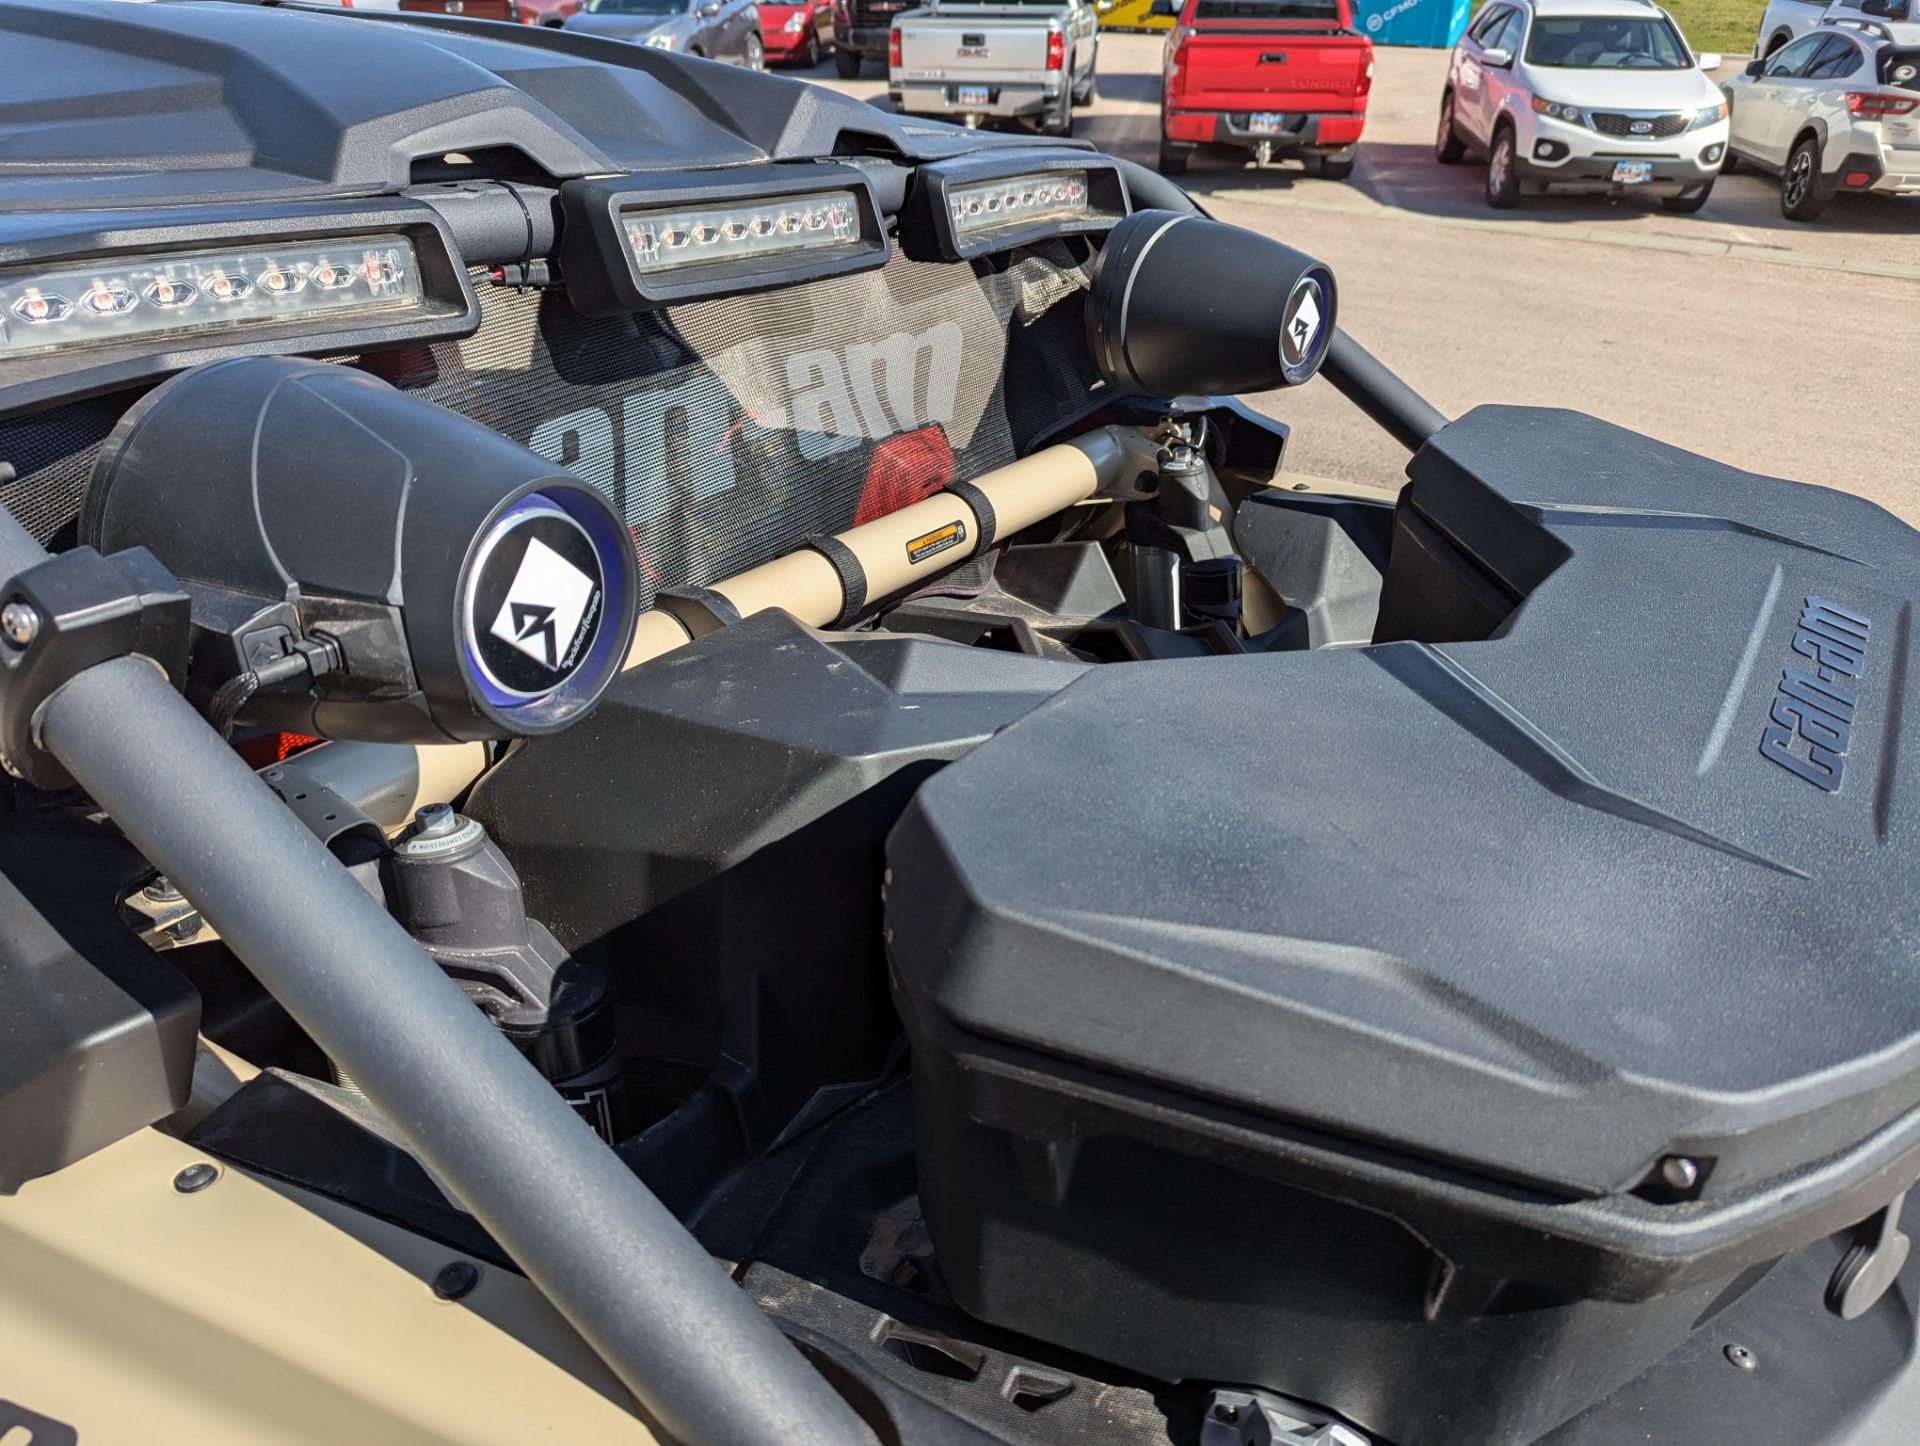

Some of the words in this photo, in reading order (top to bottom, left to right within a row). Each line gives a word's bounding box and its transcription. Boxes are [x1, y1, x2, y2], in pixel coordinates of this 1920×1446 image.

[1290, 79, 1352, 89] TUNDRA
[529, 321, 964, 527] an-am
[1759, 595, 1871, 794] can-am
